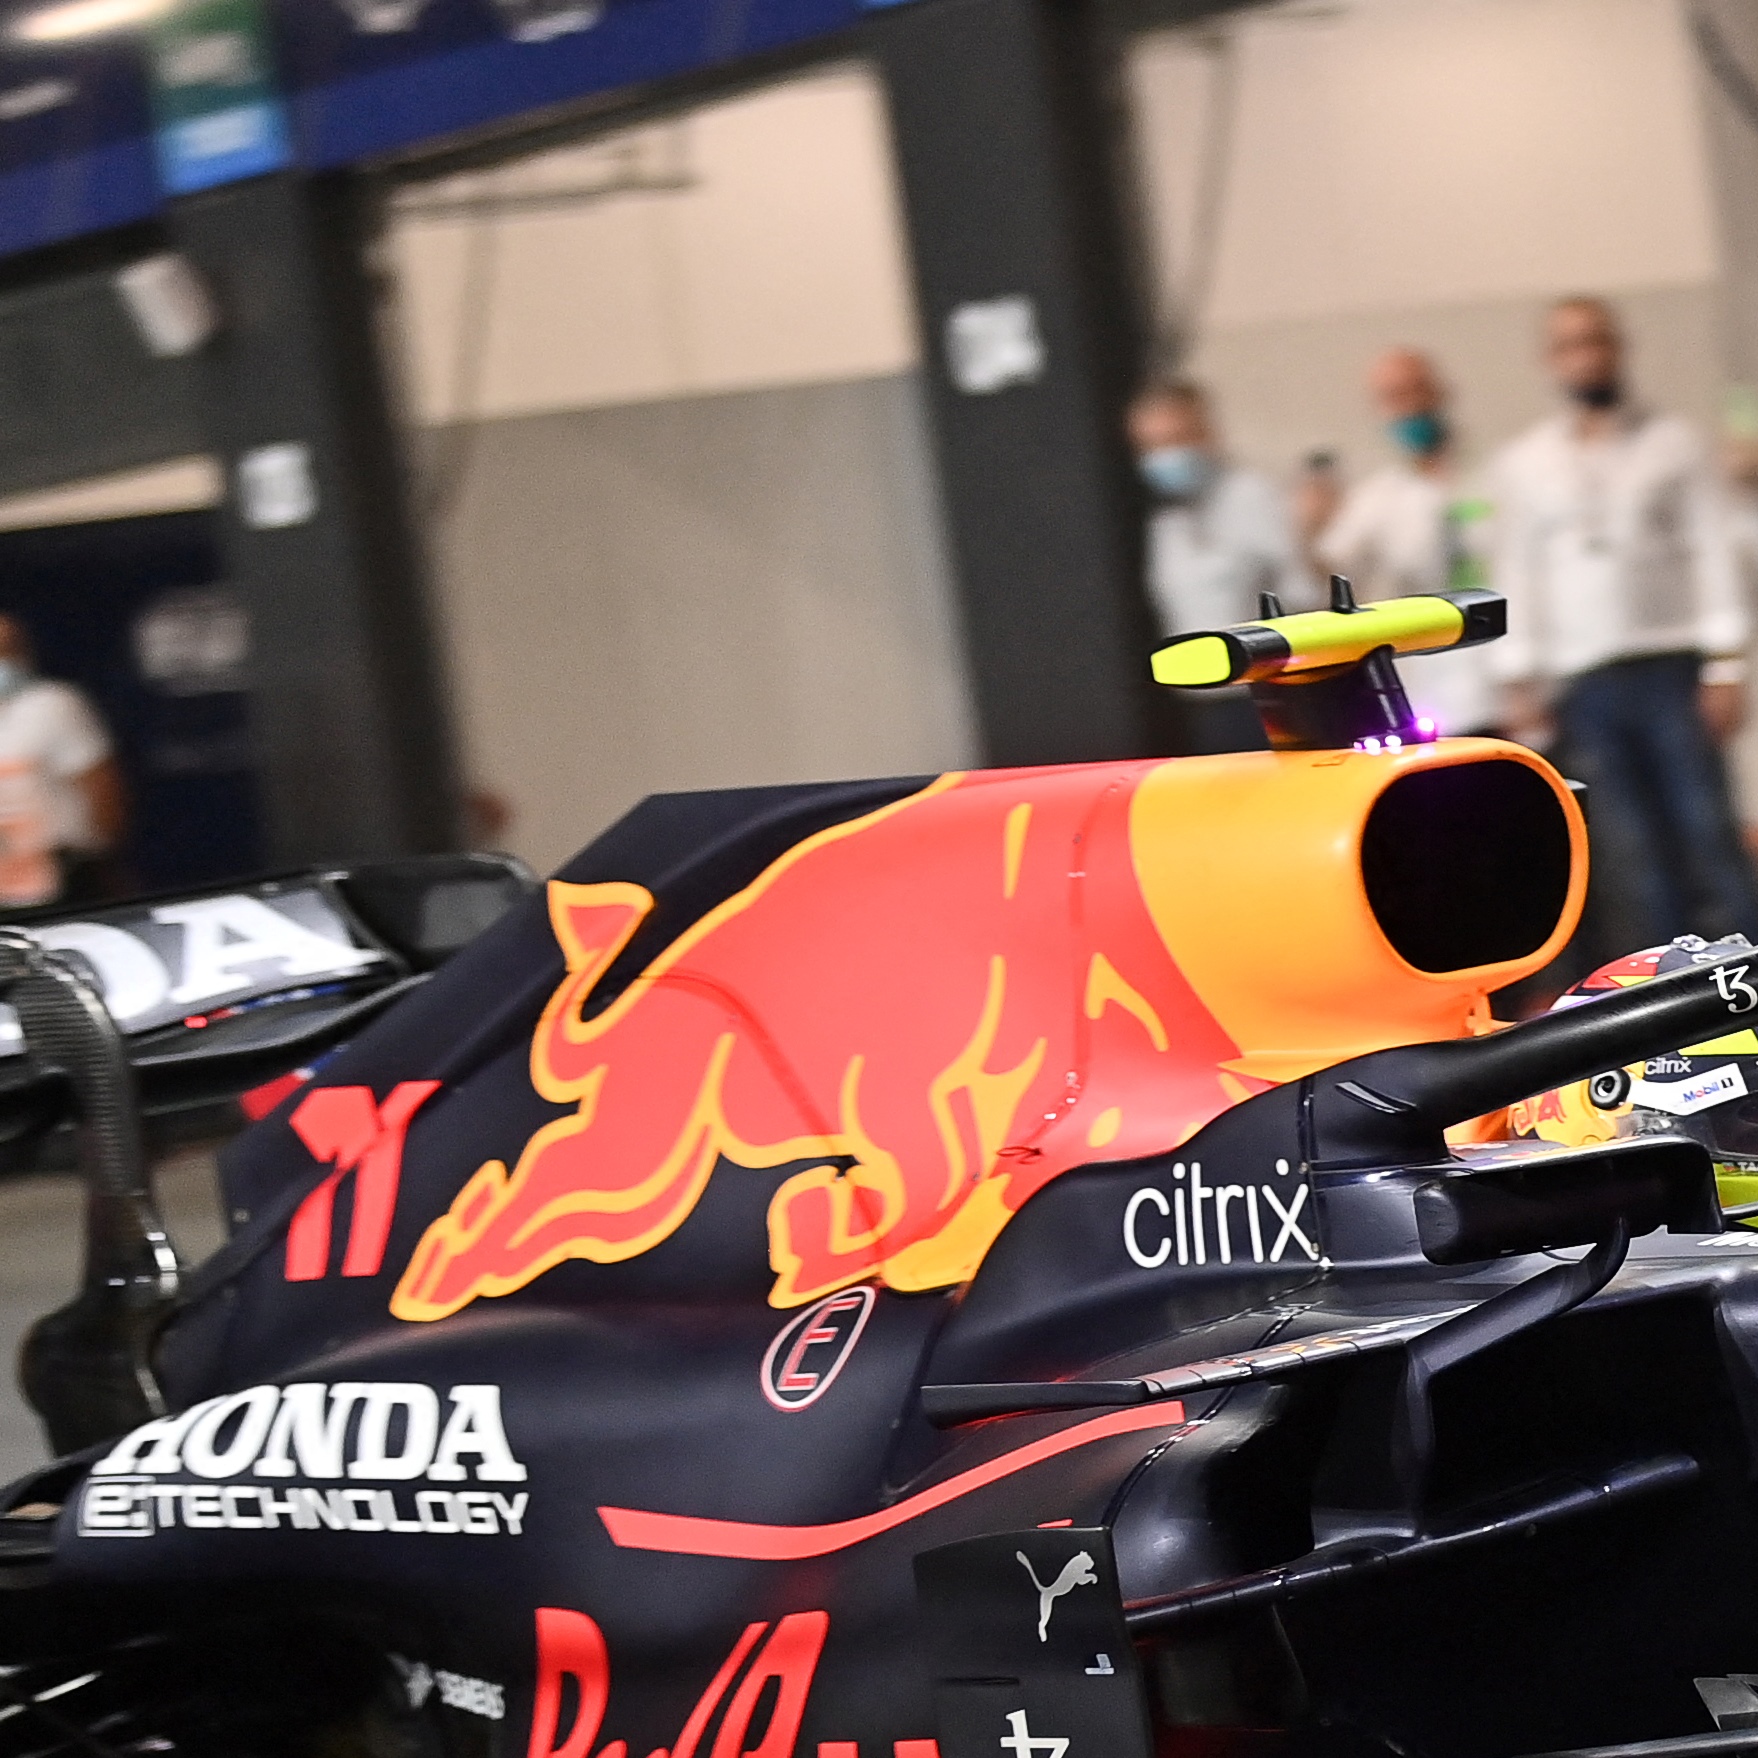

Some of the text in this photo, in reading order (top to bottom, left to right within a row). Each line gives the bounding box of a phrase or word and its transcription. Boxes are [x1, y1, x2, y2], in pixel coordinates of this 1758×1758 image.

[1645, 1056, 1693, 1076] citrix
[1682, 1081, 1721, 1103] Mobil
[1123, 1158, 1320, 1268] citrix
[90, 1382, 528, 1481] HONDA
